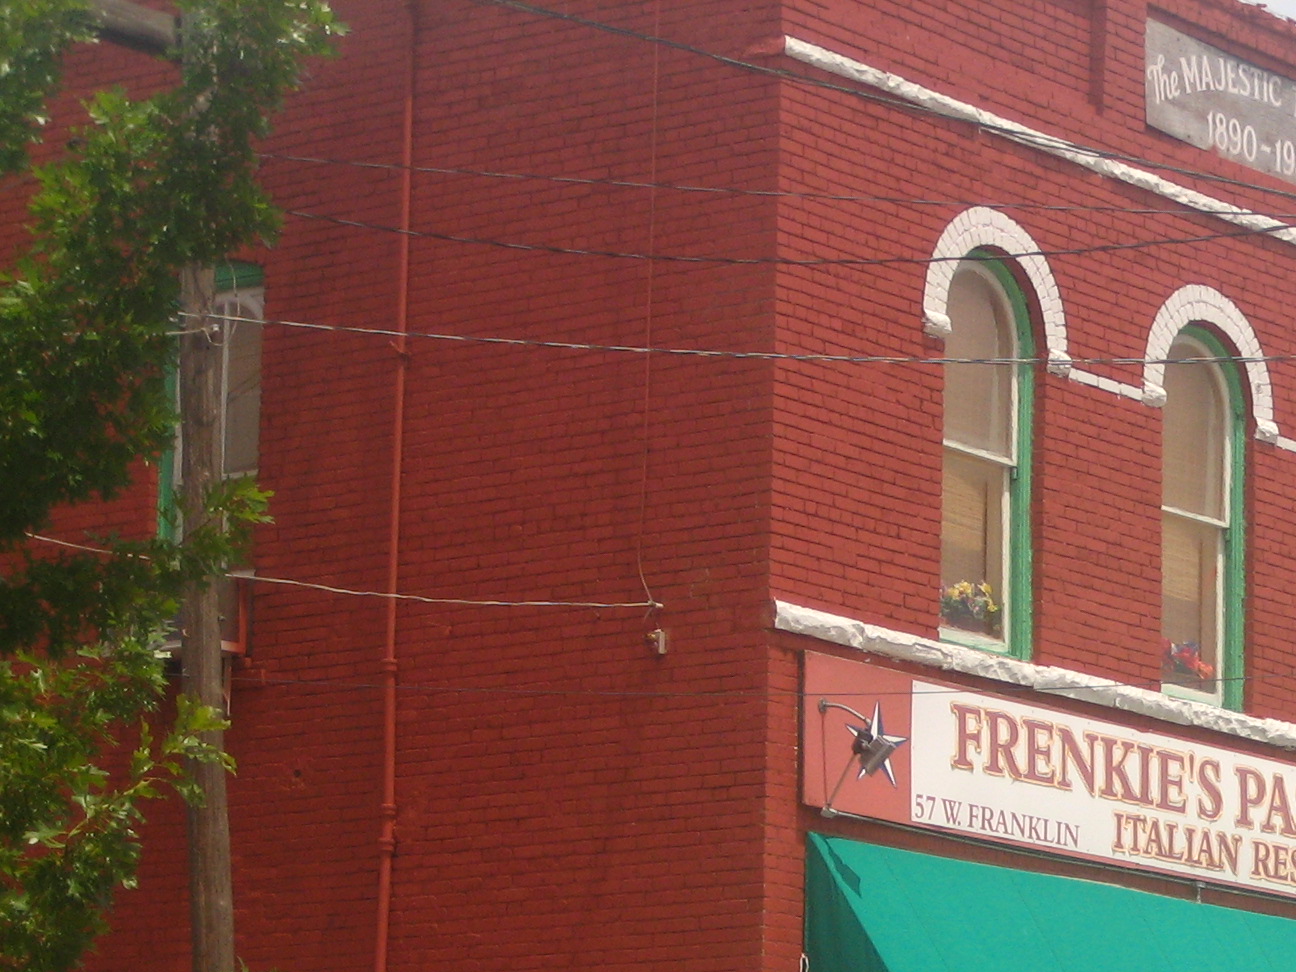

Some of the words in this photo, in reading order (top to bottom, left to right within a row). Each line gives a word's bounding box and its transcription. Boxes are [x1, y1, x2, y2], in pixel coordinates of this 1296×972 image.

[1147, 54, 1180, 104] The
[1180, 55, 1282, 107] MAJESTIC
[950, 700, 1224, 822] FRENKIE'S
[914, 794, 936, 819] 57
[941, 799, 962, 826] W.
[968, 806, 1080, 848] FRANKLIN
[1112, 810, 1243, 876] ITALIAN
